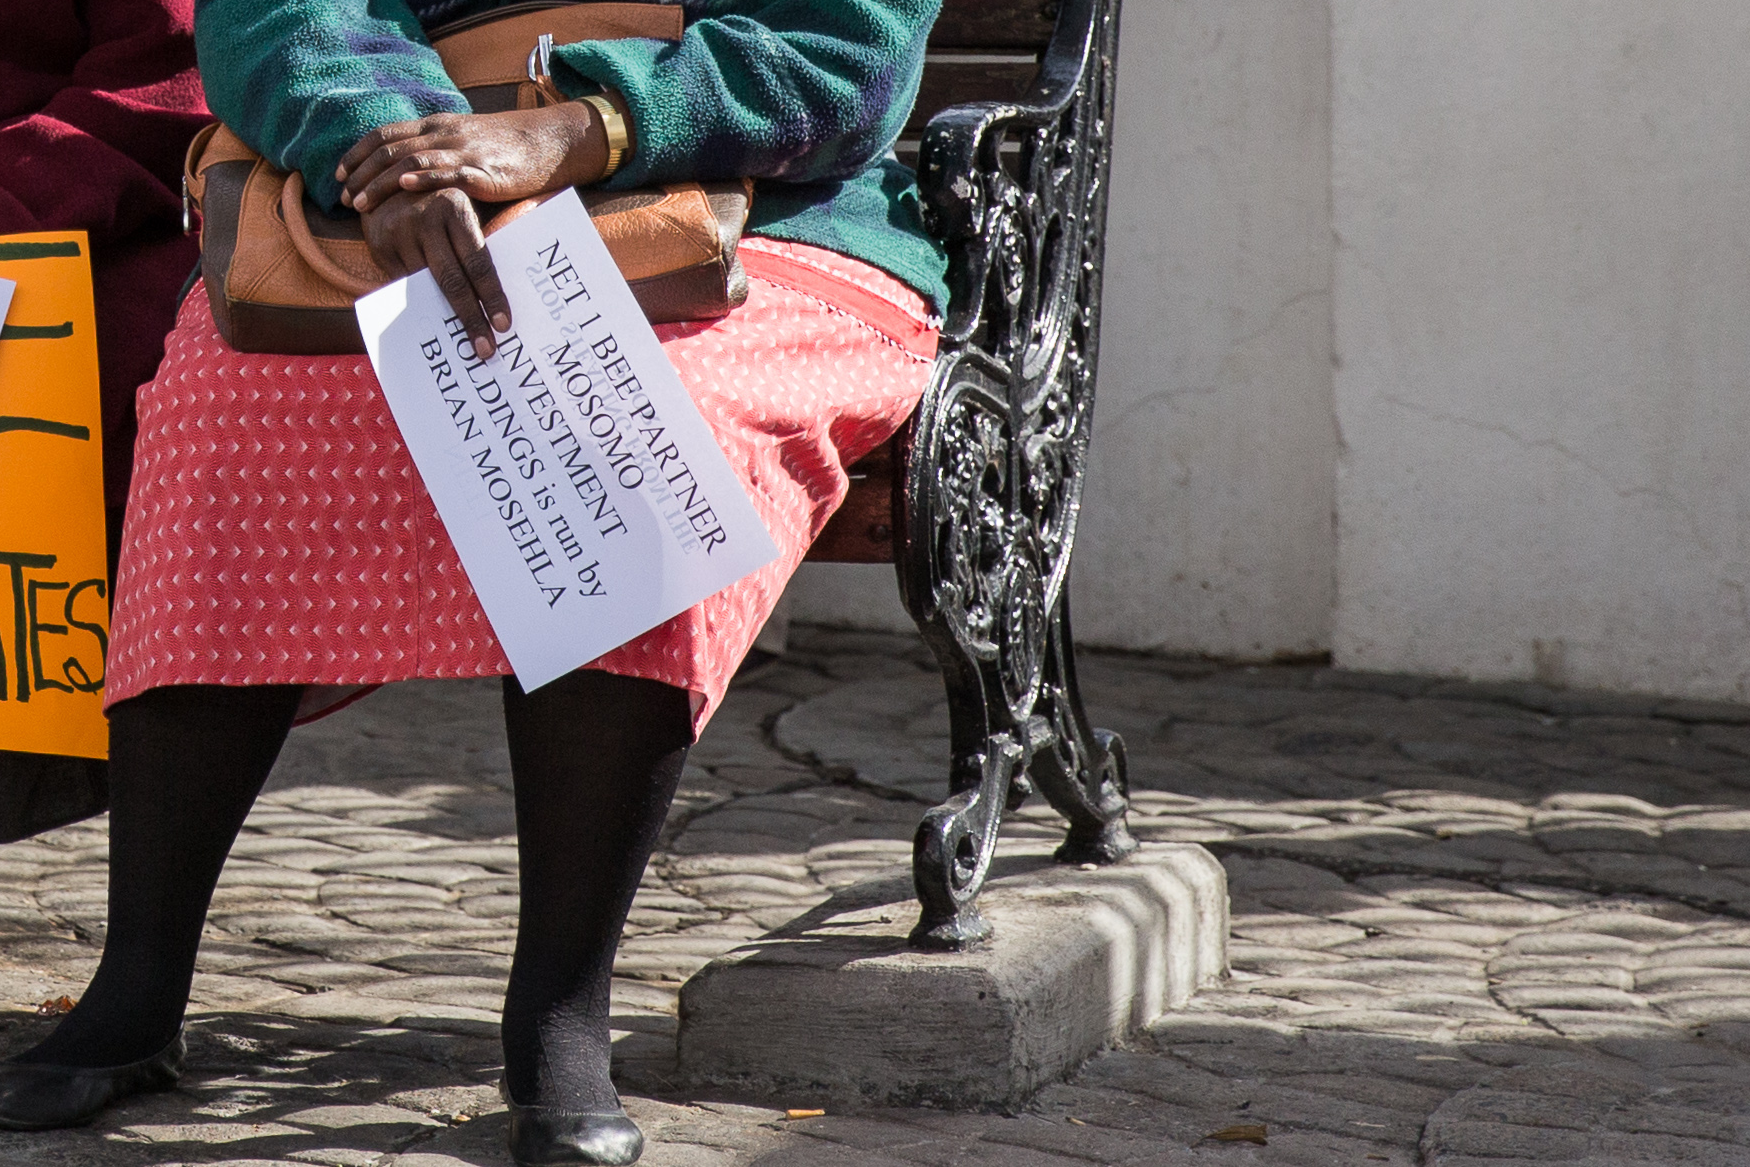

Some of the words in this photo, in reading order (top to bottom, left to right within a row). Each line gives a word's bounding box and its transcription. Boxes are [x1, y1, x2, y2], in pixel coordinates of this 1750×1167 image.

[419, 335, 483, 443] BRIAN
[470, 445, 567, 610] MOSEHLA
[442, 313, 547, 480] HOLDINGS
[532, 482, 557, 511] is
[547, 514, 584, 563] run
[577, 559, 608, 598] by
[496, 331, 628, 539] INVESTMENT
[536, 238, 592, 305] NET
[578, 312, 602, 330] 1
[591, 332, 643, 401] BEE
[629, 398, 728, 556] PARTNER
[548, 340, 645, 490] MOSOMO
